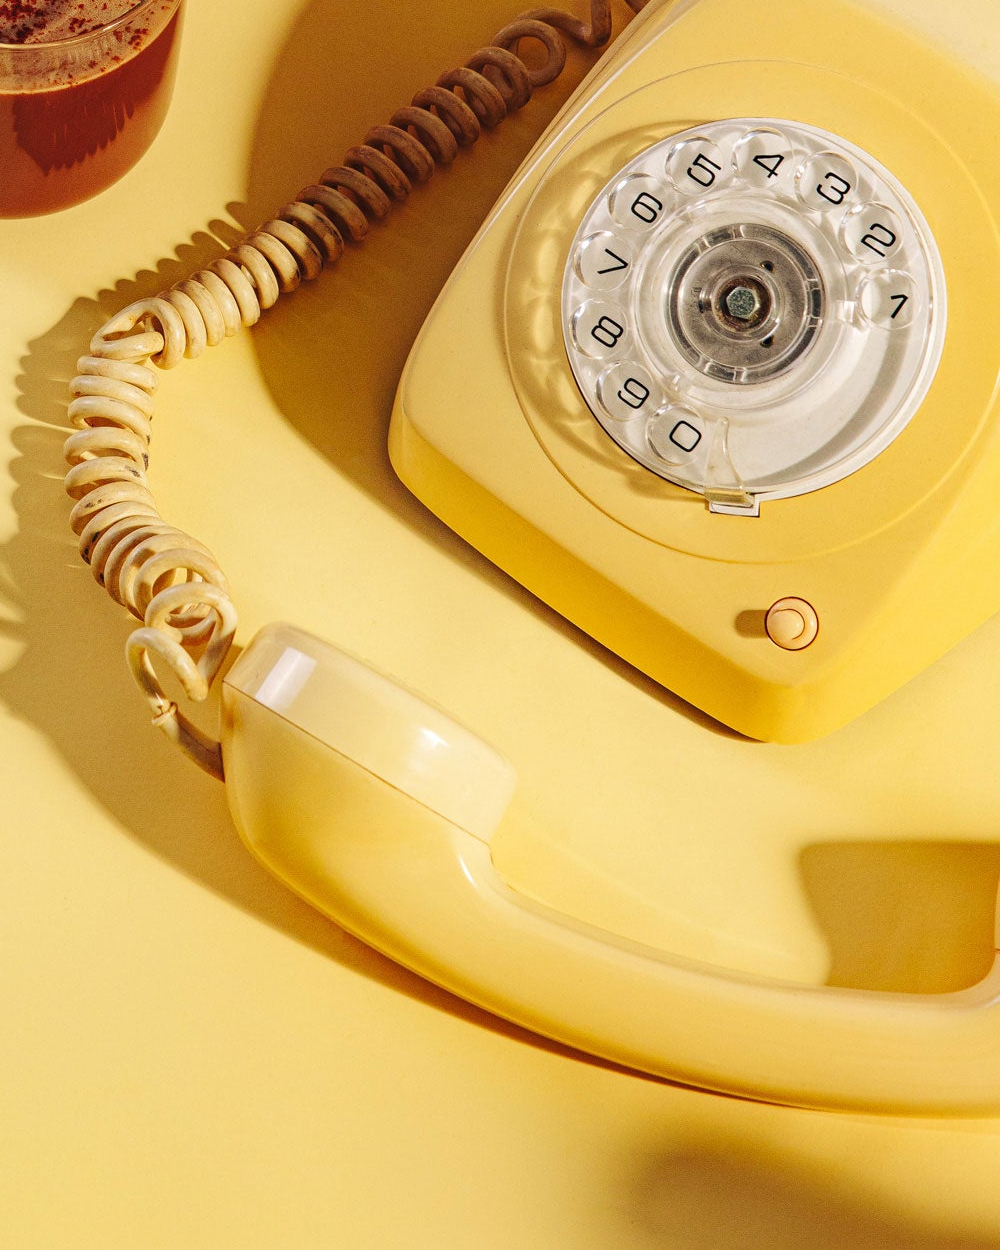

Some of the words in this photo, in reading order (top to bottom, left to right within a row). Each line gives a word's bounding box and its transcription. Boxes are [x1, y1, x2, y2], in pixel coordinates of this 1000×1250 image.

[686, 152, 723, 187] 5
[752, 153, 785, 179] 4
[815, 171, 851, 206] 3
[860, 222, 897, 258] 2
[597, 247, 629, 276] 7
[889, 293, 909, 320] 1
[590, 314, 624, 349] 8
